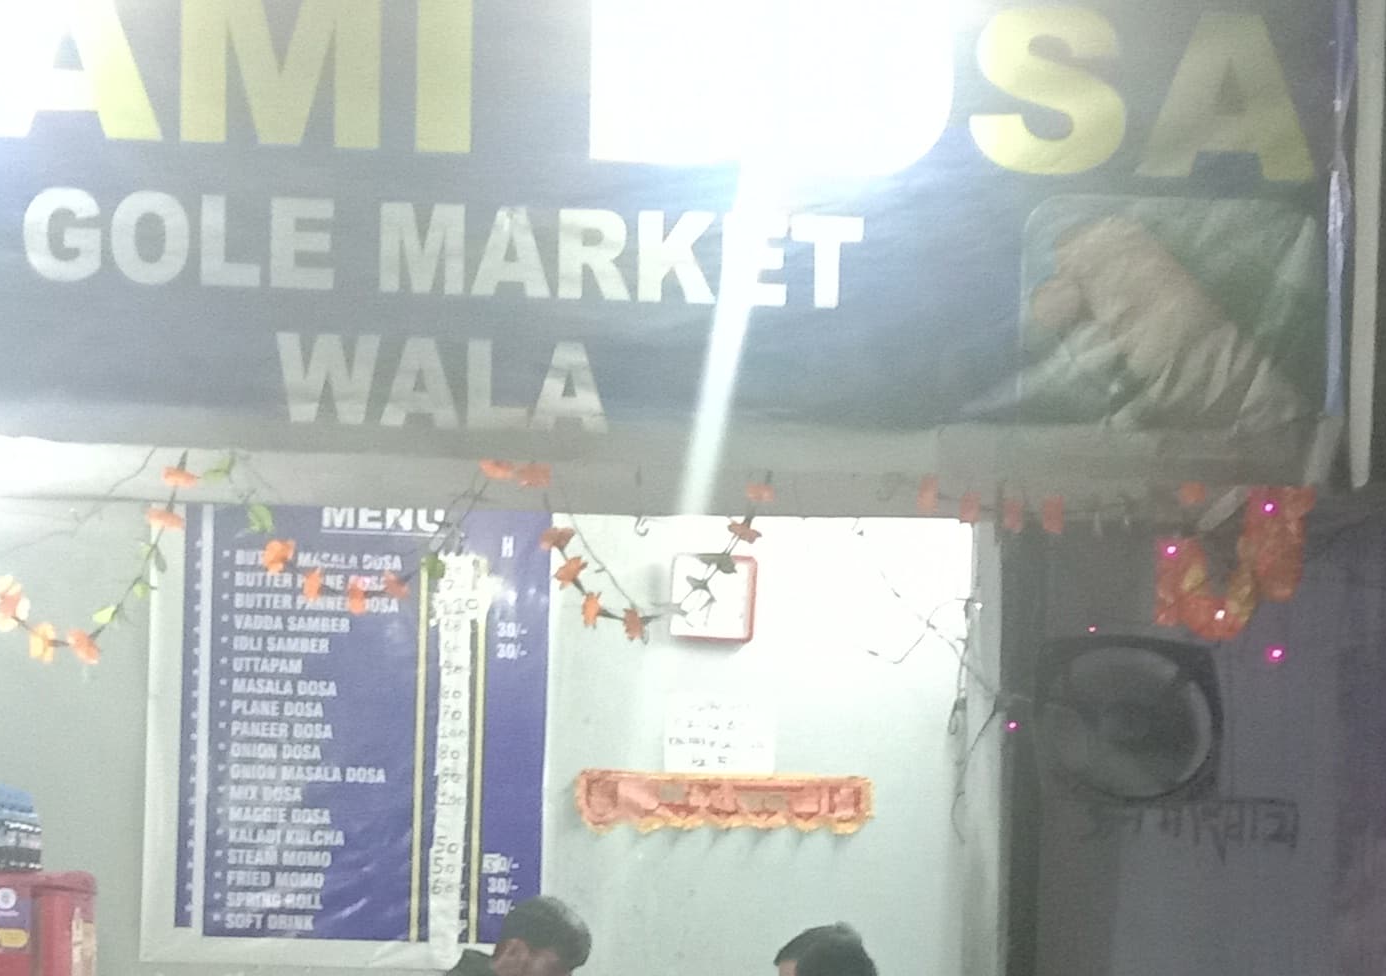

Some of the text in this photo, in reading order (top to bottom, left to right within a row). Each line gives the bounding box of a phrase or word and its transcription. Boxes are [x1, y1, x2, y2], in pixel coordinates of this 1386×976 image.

[23, 186, 864, 309] GOLE MARKET
[275, 332, 608, 434] WALA
[322, 507, 445, 531] MENU
[235, 550, 402, 571] BUT MASALA DOSA
[234, 571, 293, 588] BUTTER
[296, 573, 345, 591] PNE
[234, 593, 292, 609] BUTTER
[287, 616, 350, 633] SAMBER
[233, 636, 329, 654] IDLI SAMBER
[232, 657, 302, 674] UTTAPAM
[232, 678, 337, 697] MASALA DOSA
[231, 699, 324, 718] PLANE DOSA
[231, 720, 333, 739] PANEER DOSA
[230, 742, 321, 760] ONION DOSA
[229, 763, 386, 784] ONION MASALA DOSA
[229, 785, 303, 802] MIX DOSA
[228, 806, 331, 825] MAGGIE DOSA
[285, 830, 345, 846] KULCHA
[227, 848, 332, 867] STEAM MOMO
[226, 870, 325, 888] FRIED MOMO
[225, 891, 323, 910] SPRING ROLL
[225, 913, 314, 930] SOFT DRINK
